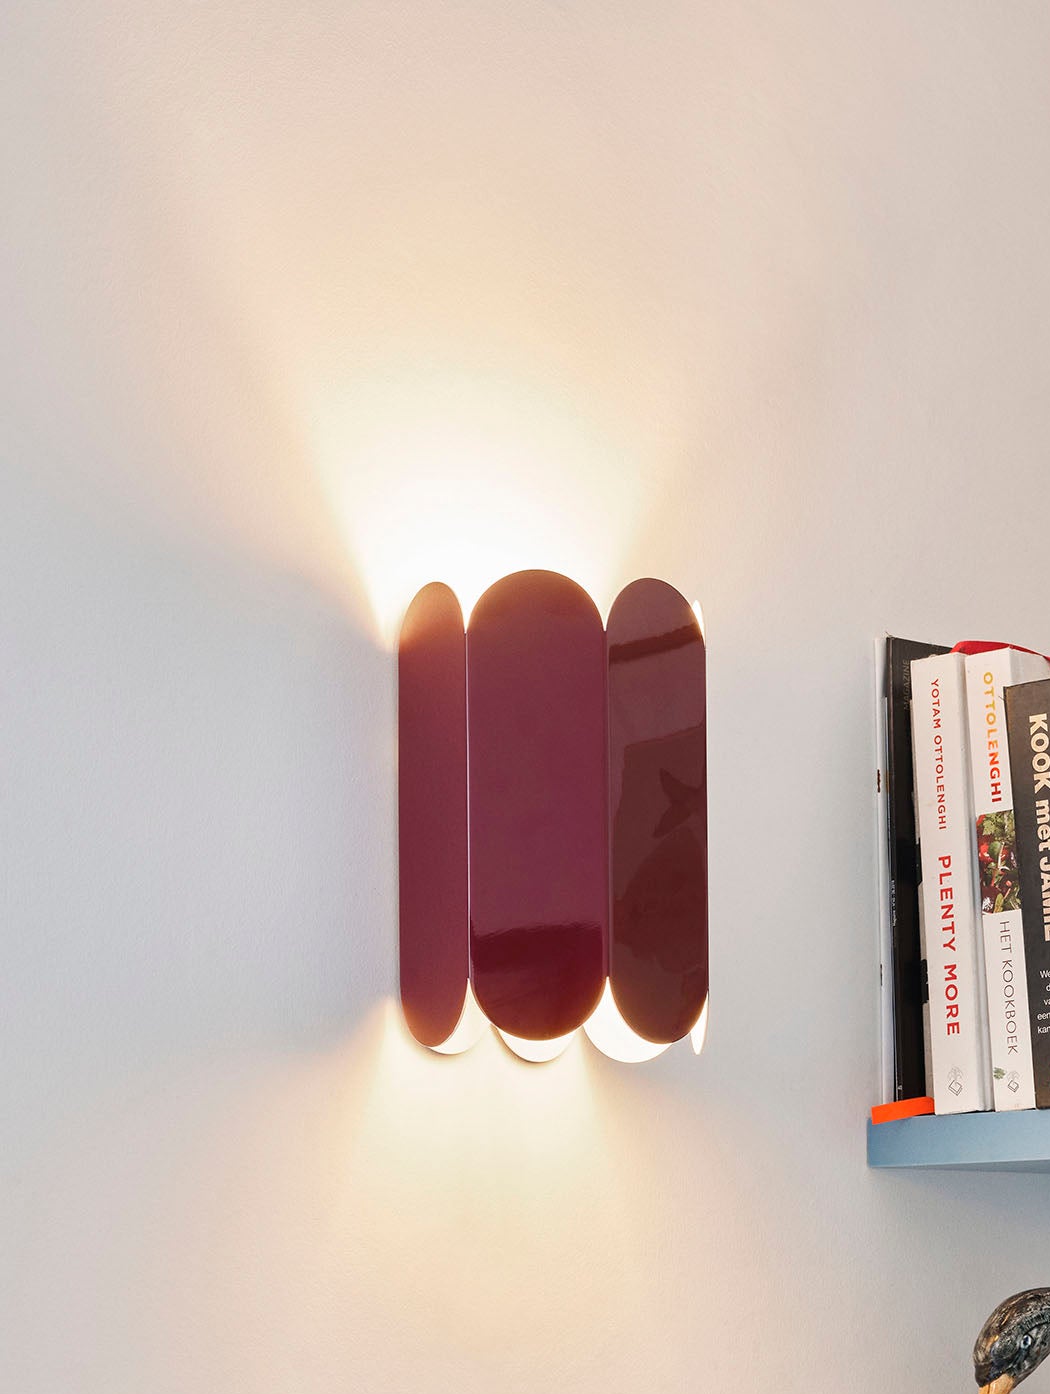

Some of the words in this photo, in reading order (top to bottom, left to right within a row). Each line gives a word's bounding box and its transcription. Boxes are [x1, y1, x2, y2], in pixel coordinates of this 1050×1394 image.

[930, 678, 942, 729] YOTAM
[983, 671, 1002, 803] OTTOLENGHI
[934, 734, 947, 830] OTTOLENGHI
[938, 855, 956, 952] PLENTY
[1000, 920, 1012, 953] HET
[943, 963, 960, 1036] MORE
[1002, 959, 1018, 1055] KOOKBOEK
[1036, 1012, 1050, 1021] een
